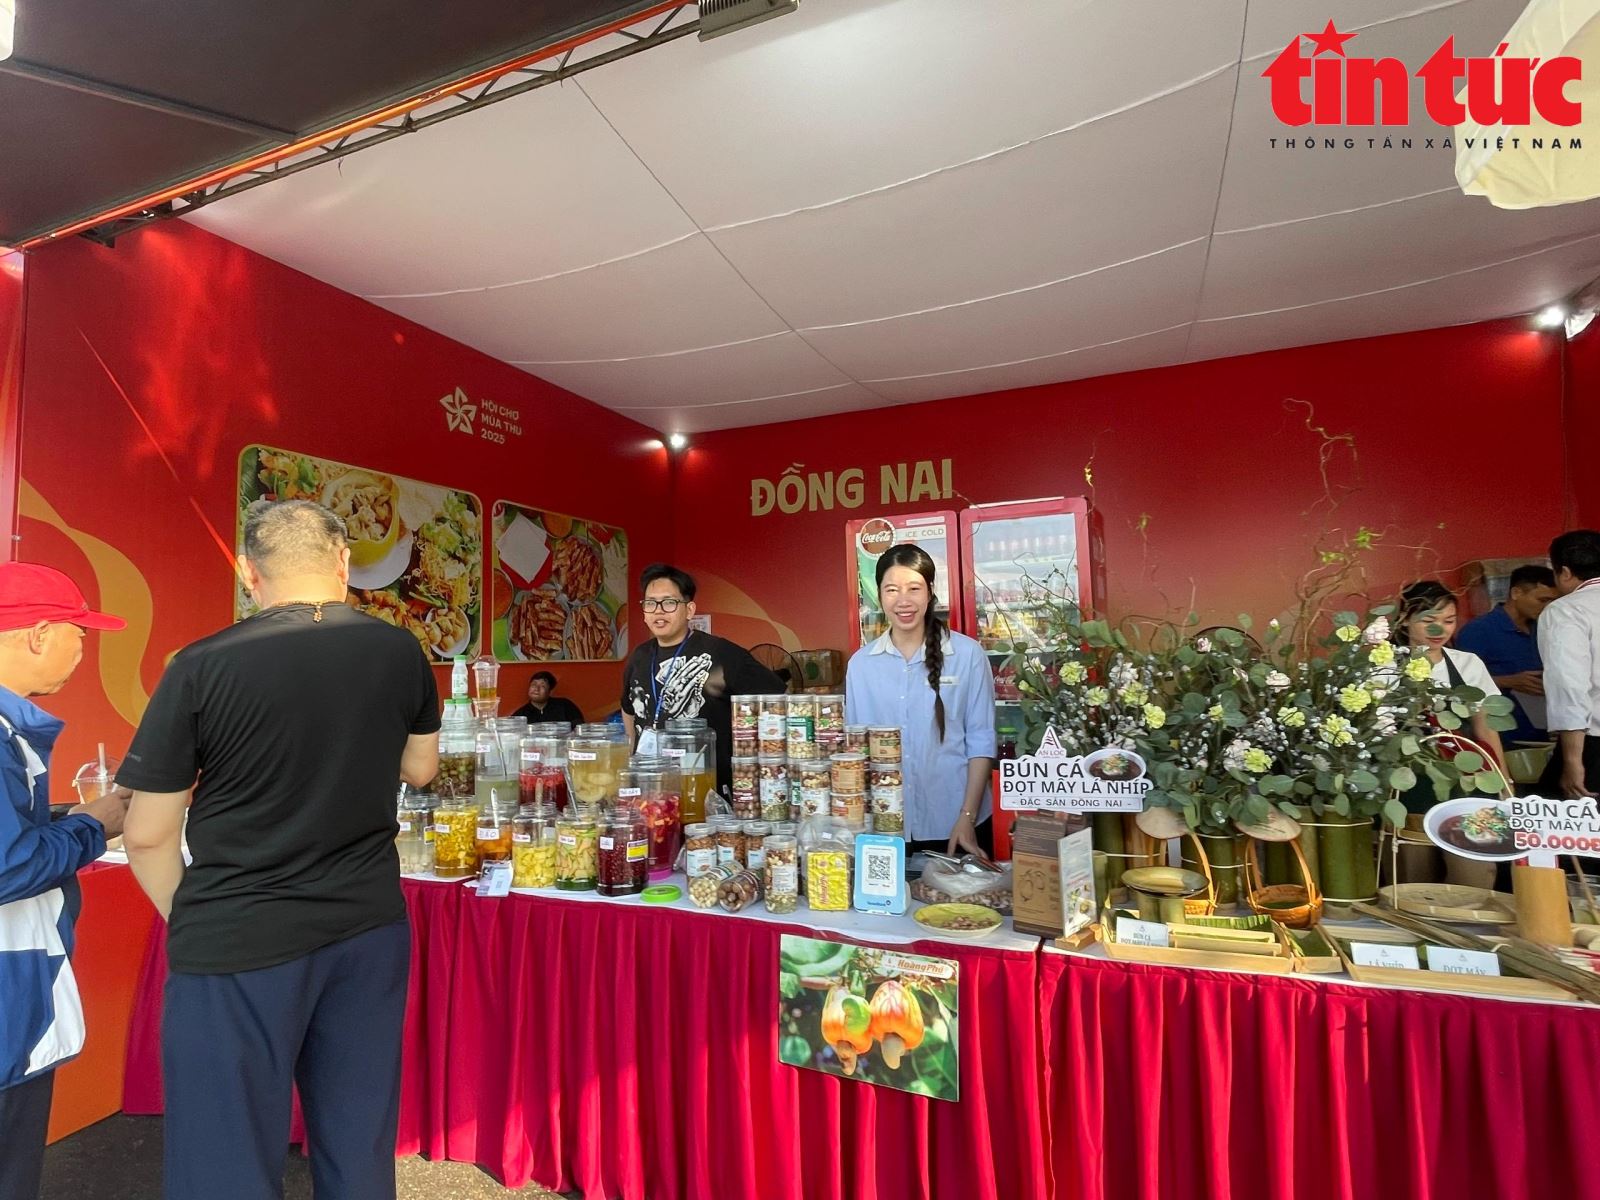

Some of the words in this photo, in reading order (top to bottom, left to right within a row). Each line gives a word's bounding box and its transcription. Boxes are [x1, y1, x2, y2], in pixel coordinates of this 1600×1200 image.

[481, 428, 505, 444] 2025
[503, 421, 523, 436] THU
[750, 462, 865, 517] ĐỒNG
[880, 458, 953, 505] NAI
[904, 530, 918, 538] ICE
[921, 527, 945, 537] COLD
[1003, 758, 1048, 778] BÚN
[1056, 758, 1085, 778] CÁ
[1003, 780, 1036, 796] ĐỌT
[1041, 777, 1077, 794] MÂY
[1082, 777, 1102, 794] LÁ
[1107, 779, 1149, 795] NHÍP
[1511, 799, 1558, 818] BÚN
[1566, 802, 1595, 820] CÁ
[1512, 818, 1543, 831] ĐỌT
[1549, 818, 1582, 833] MÂY
[1589, 821, 1600, 834] L
